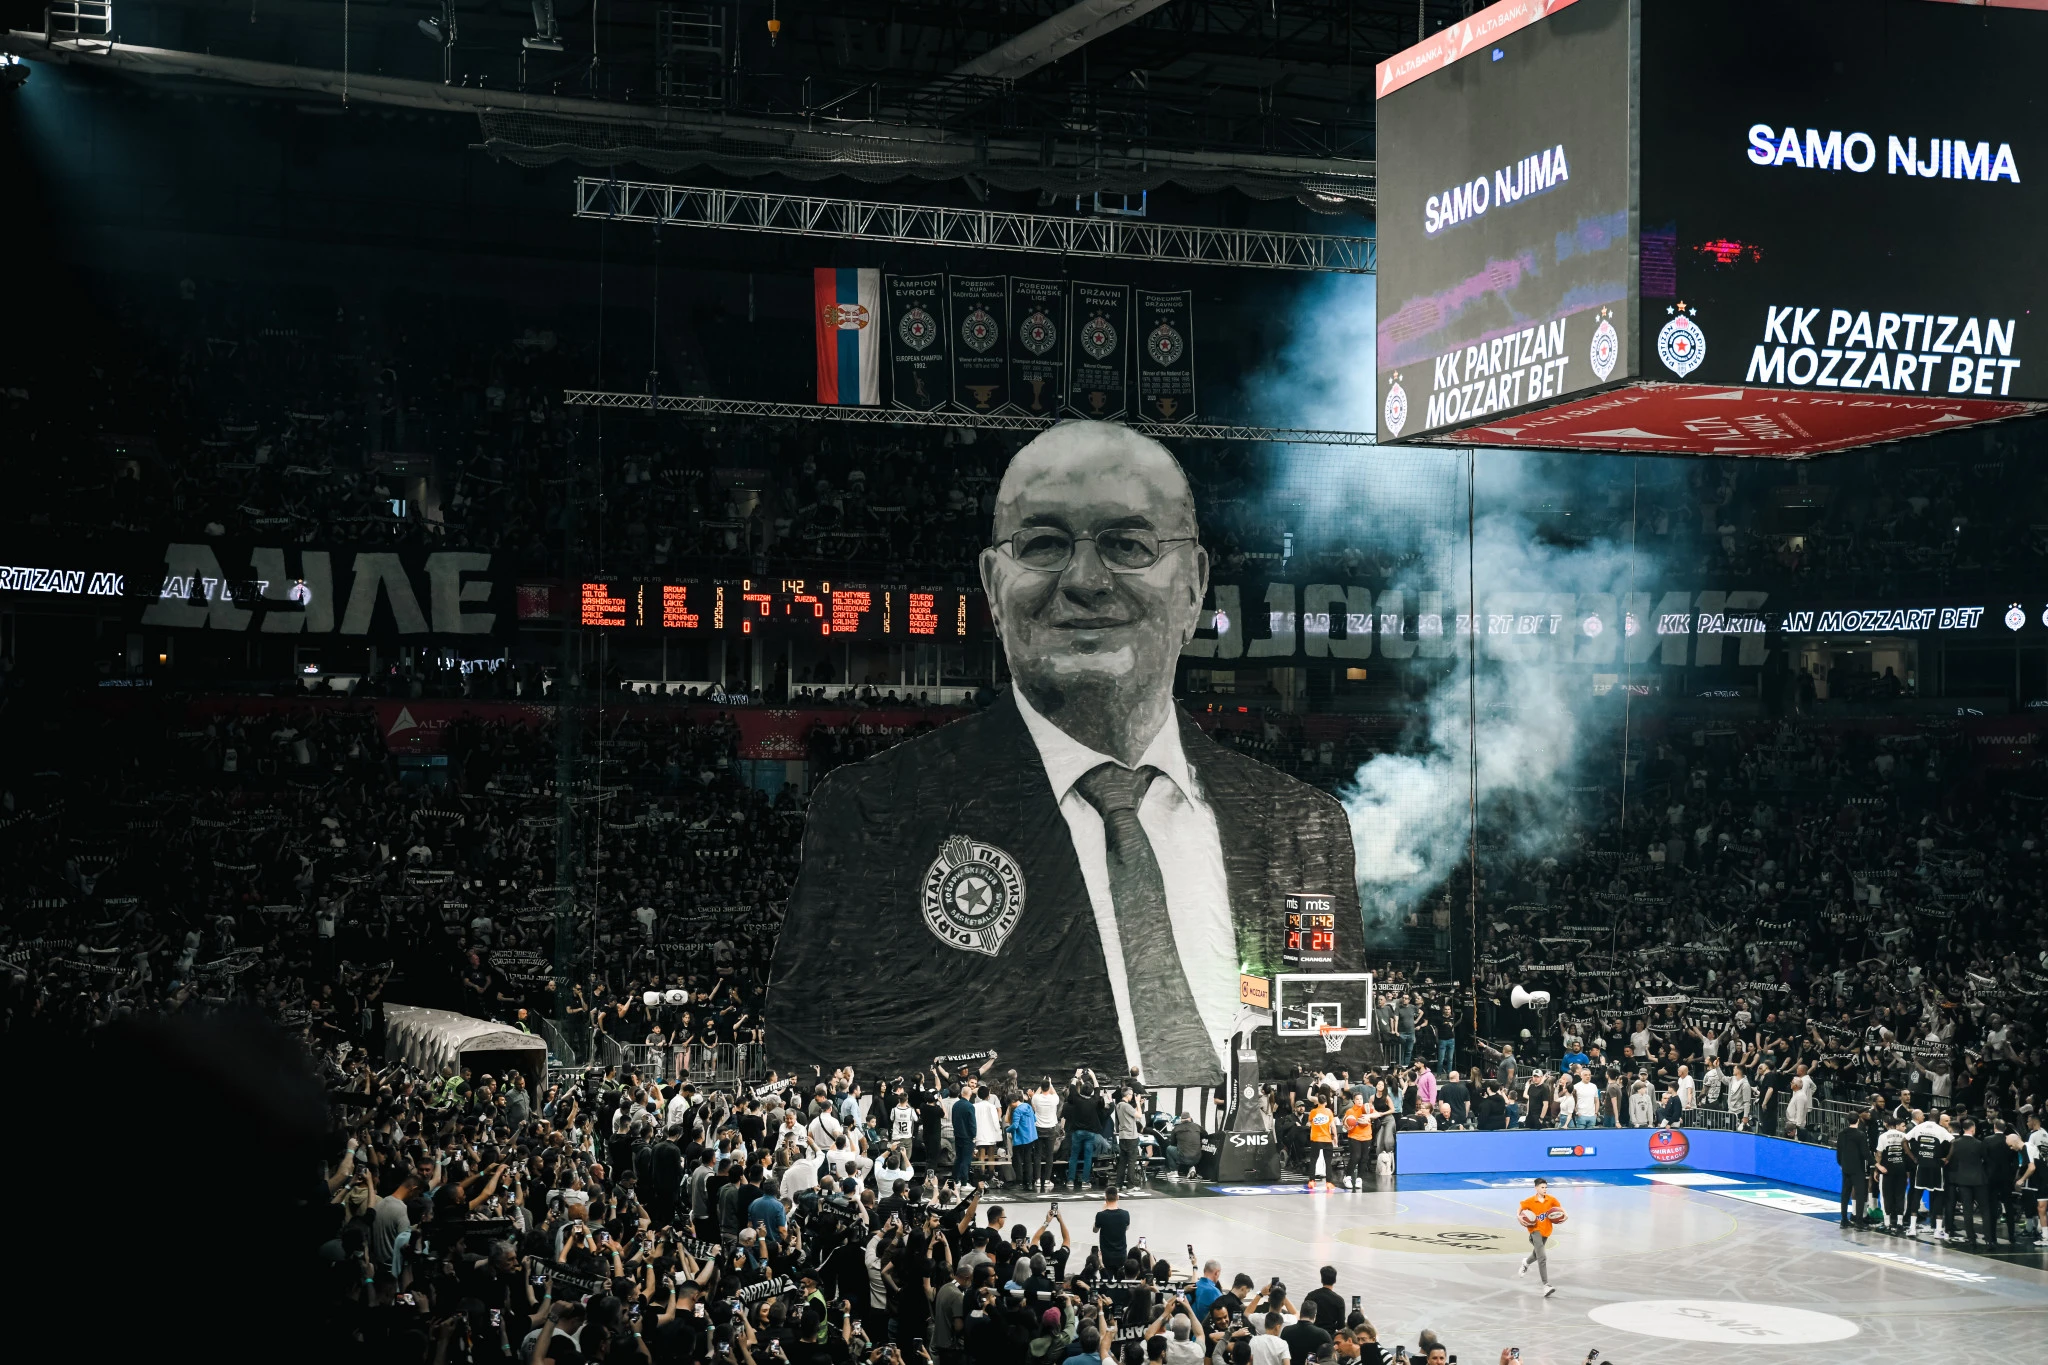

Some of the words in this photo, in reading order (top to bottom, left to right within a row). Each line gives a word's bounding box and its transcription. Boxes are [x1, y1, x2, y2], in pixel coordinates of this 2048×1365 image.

[1747, 124, 1875, 174] SAMO
[1888, 134, 2020, 183] NJIMA
[1425, 177, 1490, 234] SAMO
[1494, 144, 1569, 207] NJIMA
[896, 289, 935, 297] EVROPE
[1016, 288, 1061, 297] JADRANSKE
[1019, 283, 1058, 291] POBEDNIK
[1080, 288, 1121, 298] DRŽAVNI
[1085, 297, 1117, 307] PRVAK
[1763, 305, 1823, 344] KK
[1828, 310, 2016, 354] PARTIZAN
[1433, 351, 1462, 391] KK
[1464, 318, 1566, 382] PARTIZAN
[1746, 345, 1944, 390] MOZZART
[1948, 357, 2020, 395] BET
[1425, 369, 1525, 430] MOZZART
[1527, 356, 1569, 403] BET
[743, 579, 750, 591] 0
[823, 582, 830, 594] 0
[743, 594, 771, 602] PARTIZAN
[794, 595, 818, 603] ZVEZDA
[909, 593, 934, 601] RIVERO
[761, 602, 769, 616] 0
[814, 603, 823, 617] 0
[663, 620, 698, 628] CALATHES
[1658, 613, 1692, 635] KK
[1817, 606, 1935, 634] MOZZART
[1939, 606, 1985, 631] BET
[743, 621, 750, 633] 0
[822, 623, 830, 635] 0
[909, 627, 934, 635] MONEKE
[979, 849, 1020, 931] ПАРТИЗАН
[105, 897, 138, 905] PARTIZAN
[928, 866, 971, 945] PARTIZAN
[1286, 898, 1299, 910] mts
[1305, 899, 1330, 911] mts
[950, 909, 995, 927] BASKETBALL
[1312, 915, 1333, 927] 1:42
[743, 921, 781, 932] ГРОБАР
[1289, 931, 1299, 948] 24
[1312, 933, 1334, 951] 24
[1749, 981, 1779, 992] PARTIZAN
[1249, 987, 1268, 999] MOZZART
[946, 1051, 987, 1061] ПАРТИЗАН
[756, 1078, 790, 1096] ПАРТИЗАН
[1246, 1134, 1269, 1146] NIS
[739, 1276, 782, 1304] PARTIZAN
